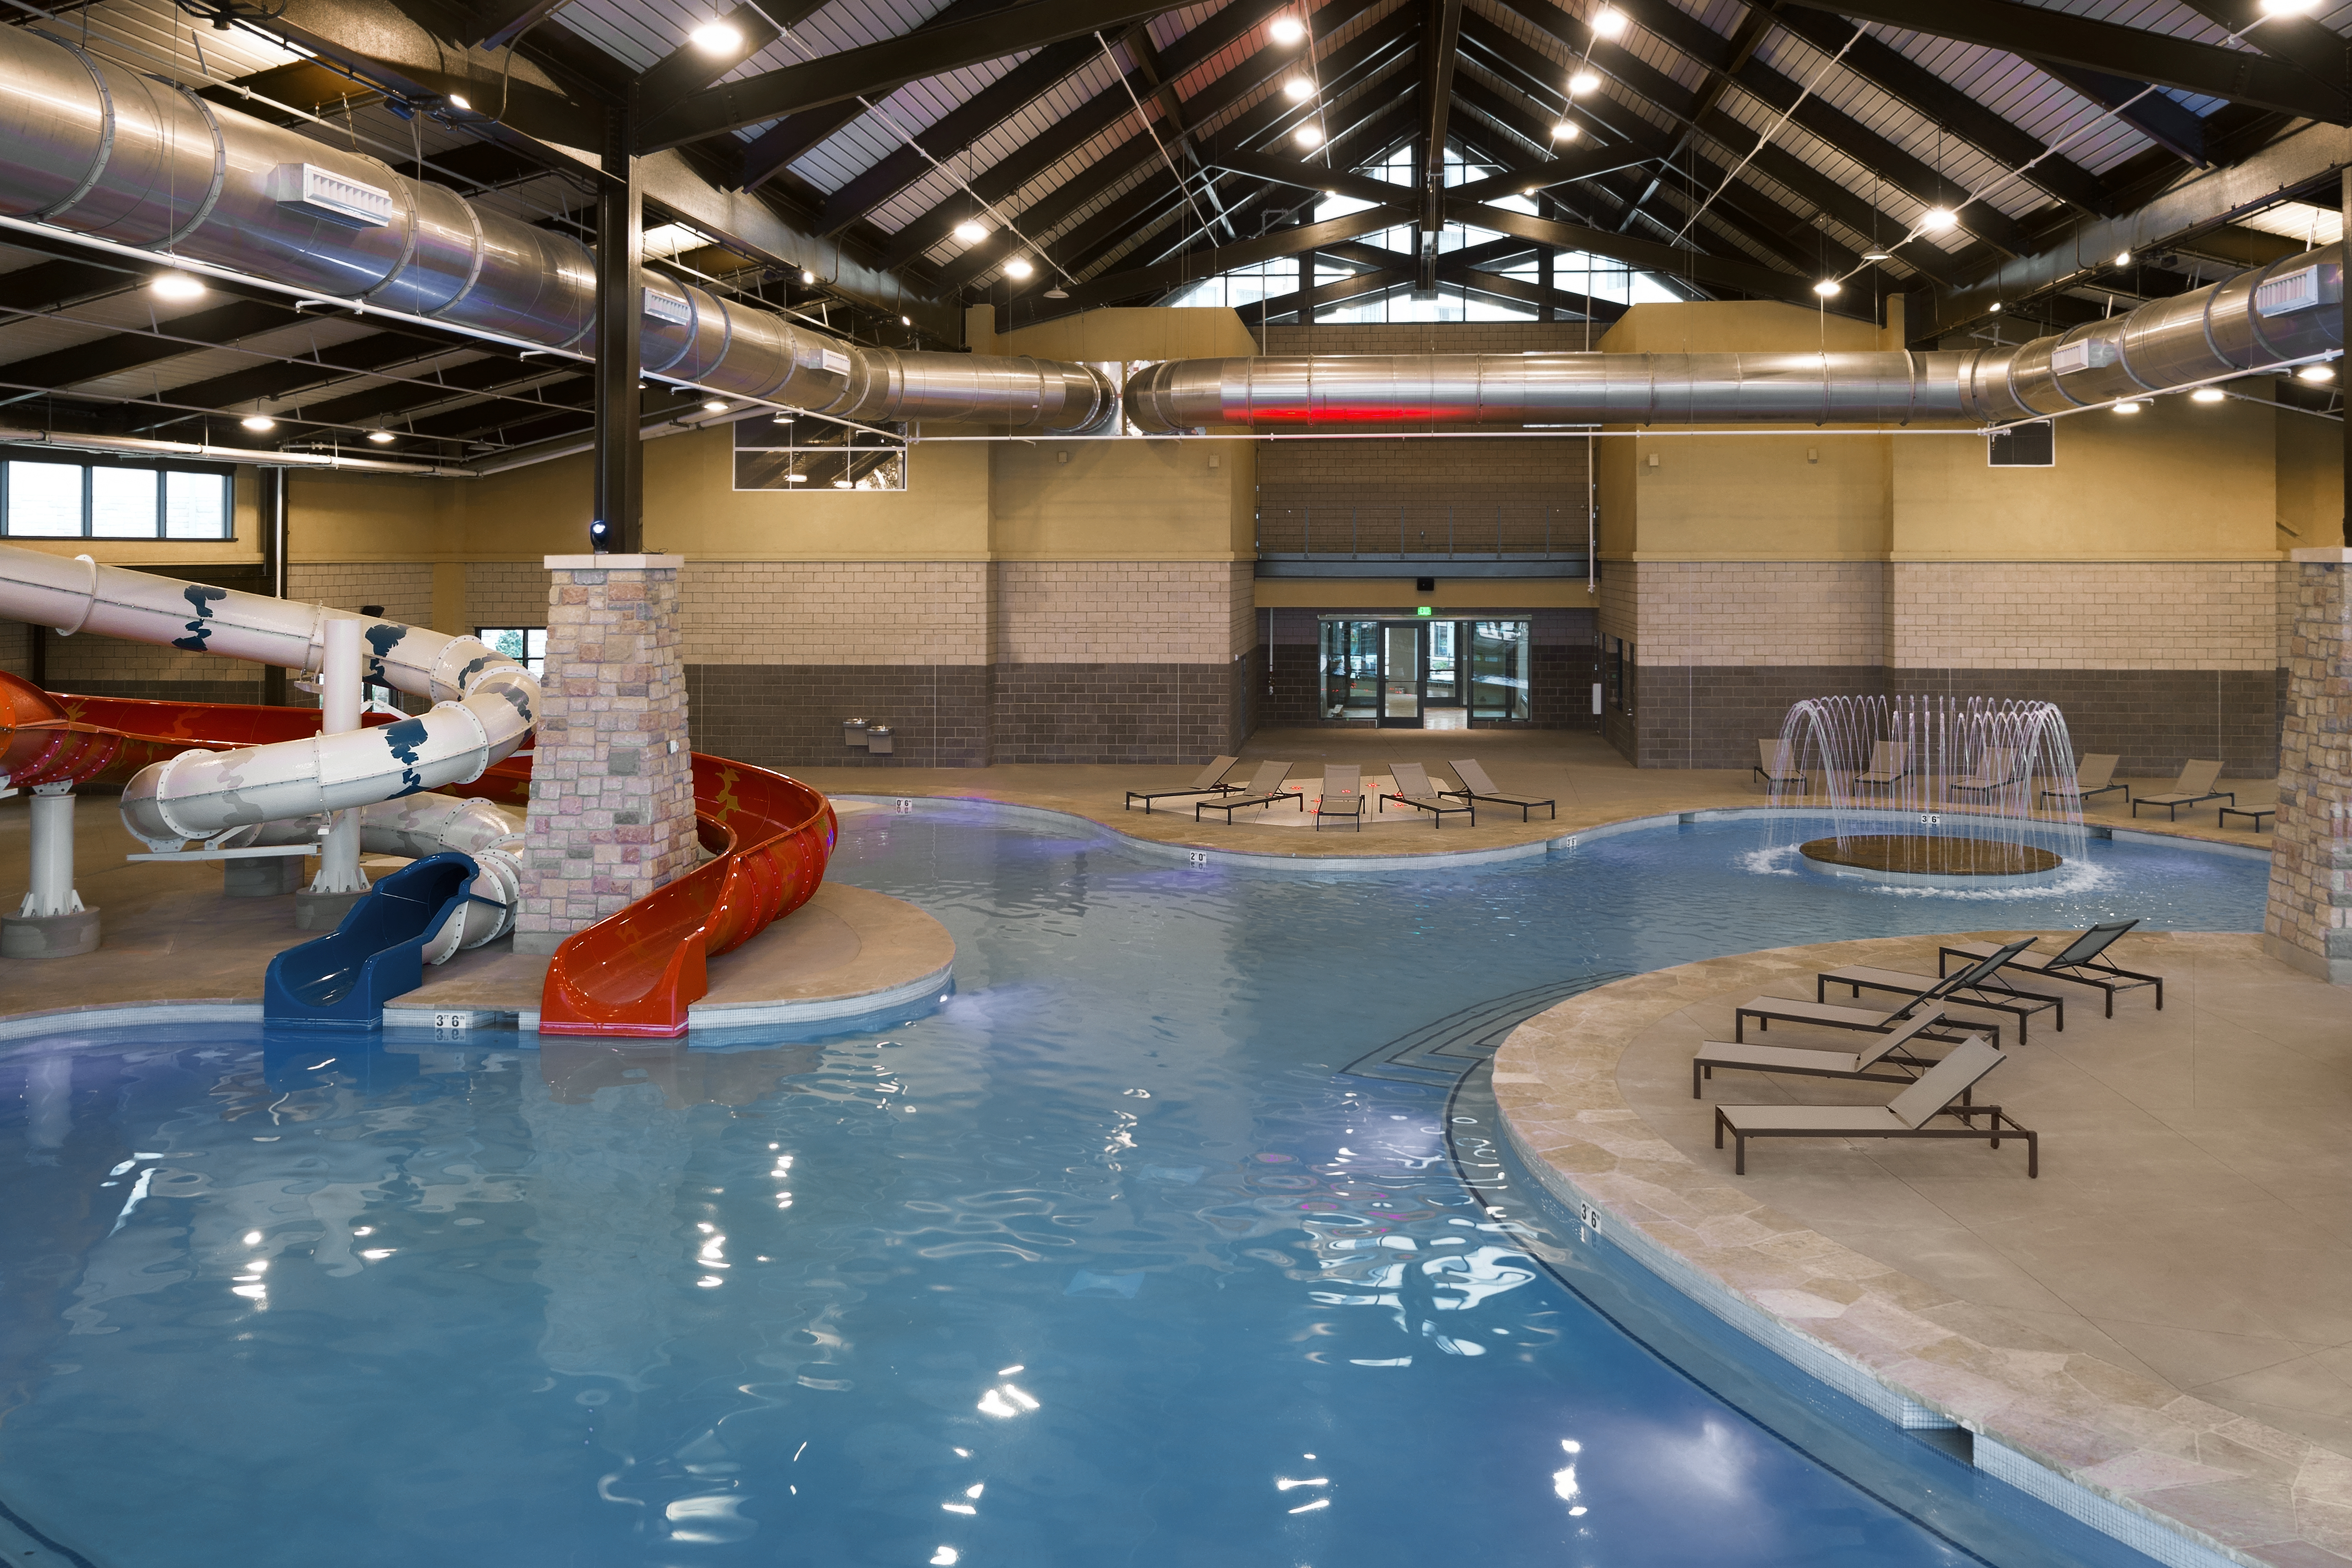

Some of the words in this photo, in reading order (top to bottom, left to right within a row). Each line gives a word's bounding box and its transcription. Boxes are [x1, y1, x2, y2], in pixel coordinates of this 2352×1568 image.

[436, 1015, 444, 1026] 3
[452, 1016, 459, 1027] 6
[1582, 1203, 1587, 1220] 3
[1591, 1211, 1596, 1228] 6
